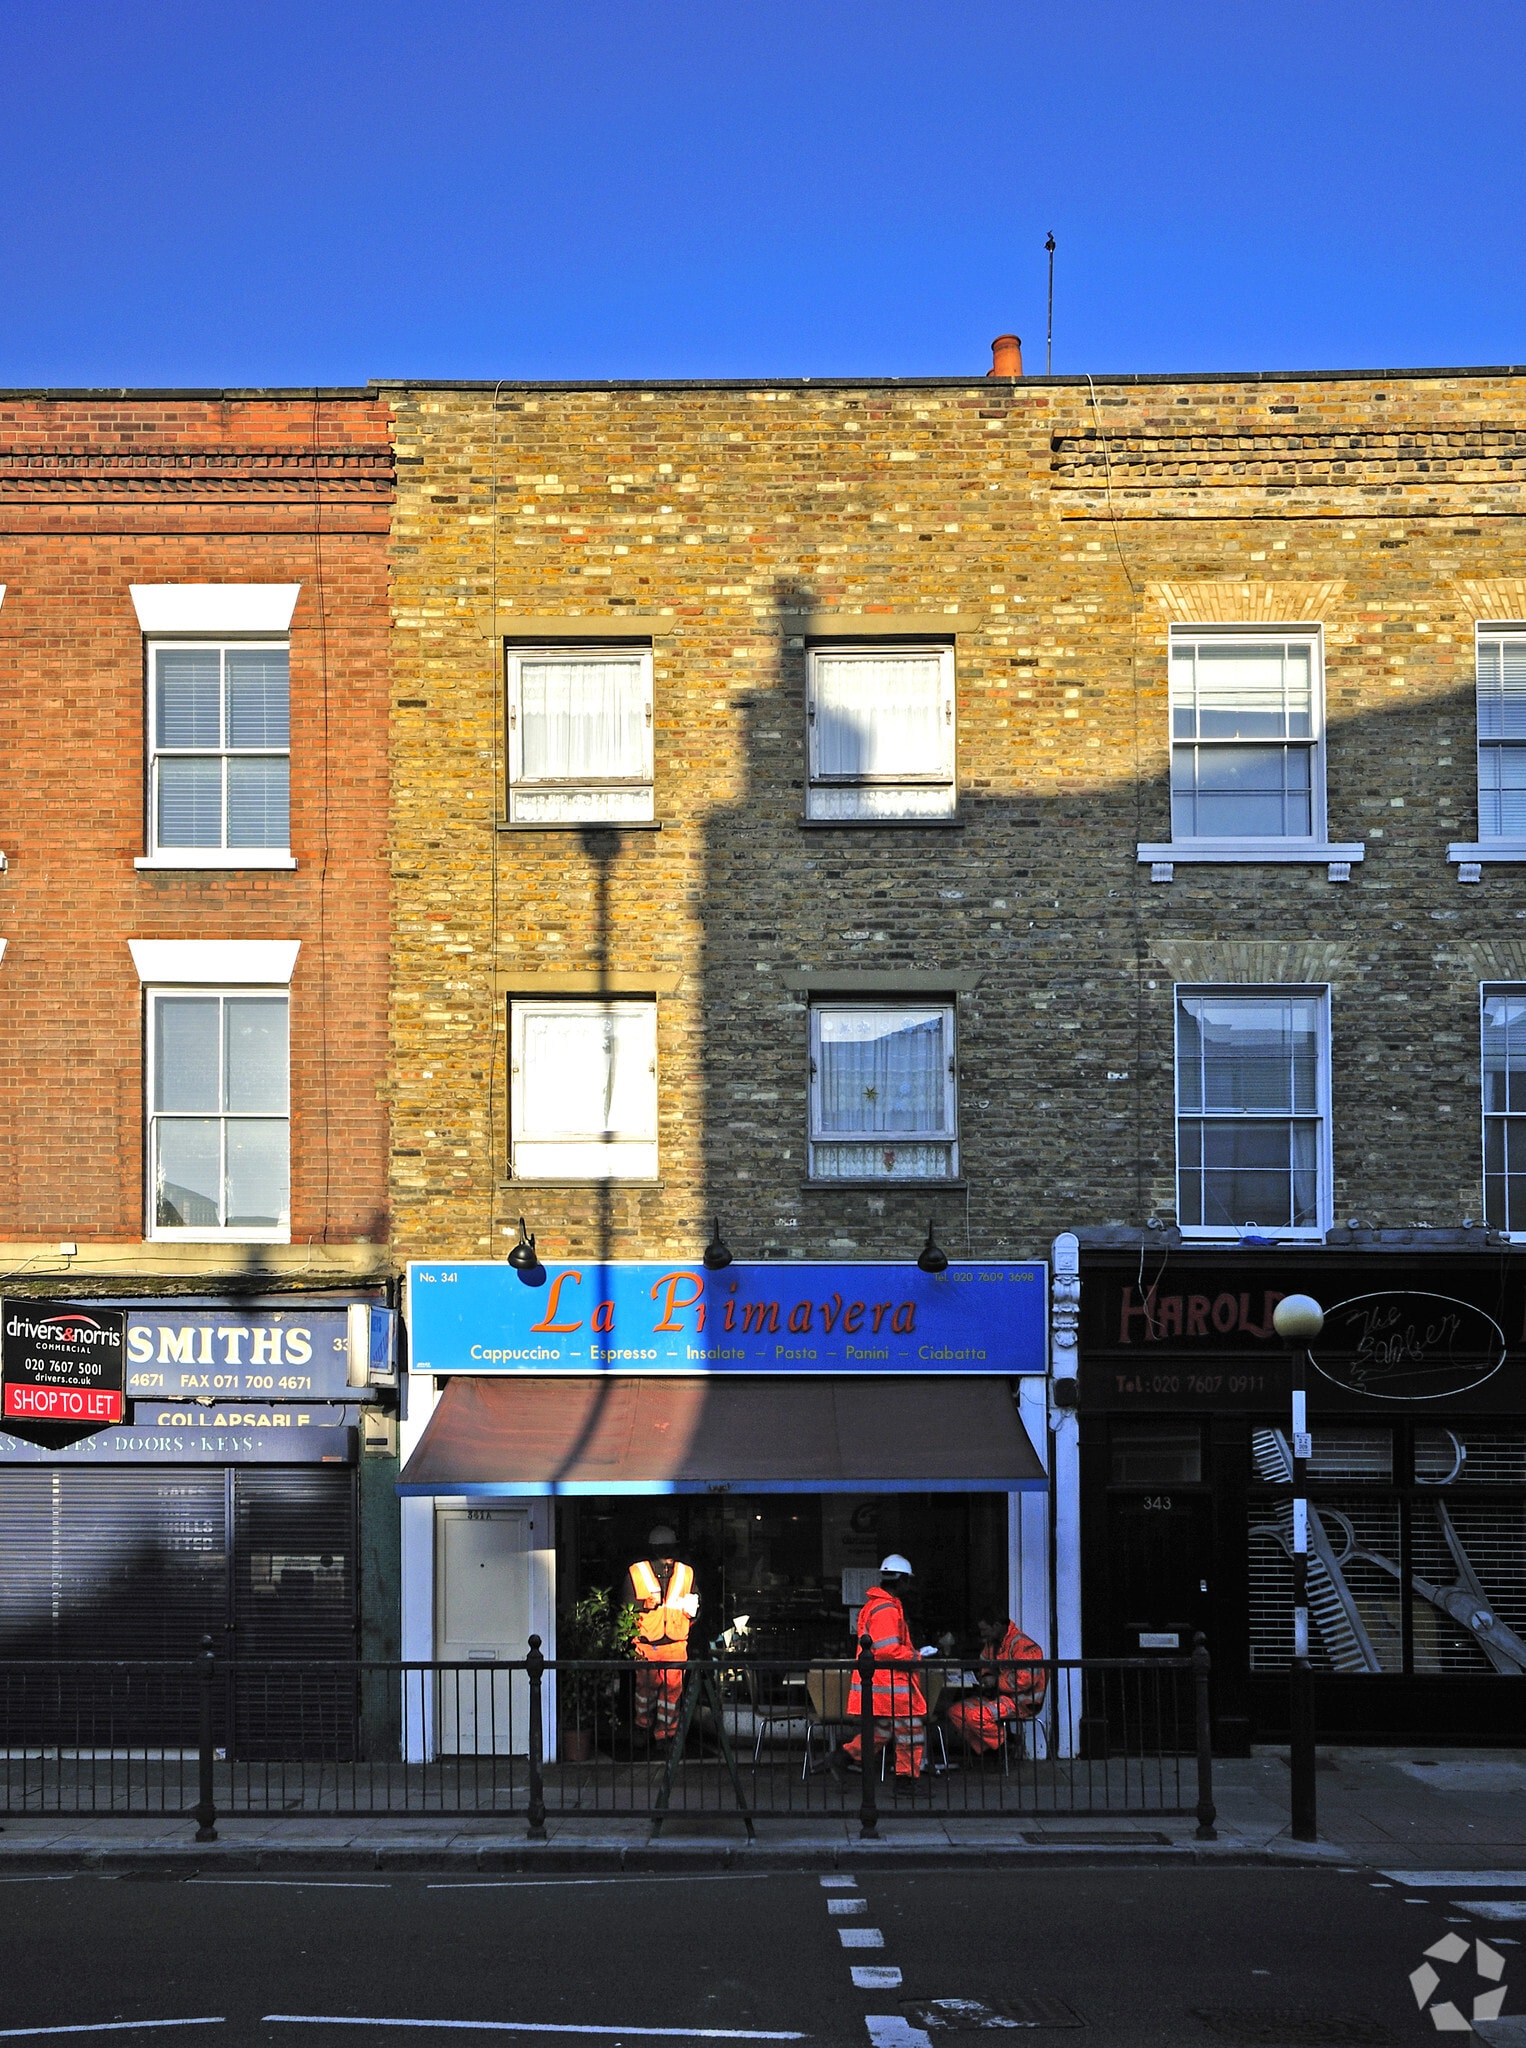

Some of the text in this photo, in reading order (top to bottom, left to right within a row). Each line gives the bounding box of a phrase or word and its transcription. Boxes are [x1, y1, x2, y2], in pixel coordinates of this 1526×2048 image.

[419, 1272, 458, 1283] No. 341
[953, 1272, 973, 1282] 020
[978, 1272, 1004, 1282] 7609
[1009, 1272, 1034, 1282] 3698
[530, 1270, 916, 1334] La Primavera
[6, 1314, 121, 1347] drivers&norris
[36, 1342, 91, 1354] COMMERCIAL
[127, 1326, 313, 1365] SMITHS
[470, 1344, 986, 1364] Cappuccino Espresso Insalate Pasta Panini Ciabatta
[25, 1358, 102, 1376] 020 7607 5001
[35, 1373, 91, 1385] drivers.co.uk
[130, 1373, 311, 1390] 4671 FAX 071 700 4671
[1187, 1376, 1223, 1393] 7607
[14, 1389, 114, 1415] SHOP TO LET
[115, 1437, 183, 1451] DOORS
[201, 1437, 253, 1451] KEYS
[1143, 1495, 1172, 1510] 343
